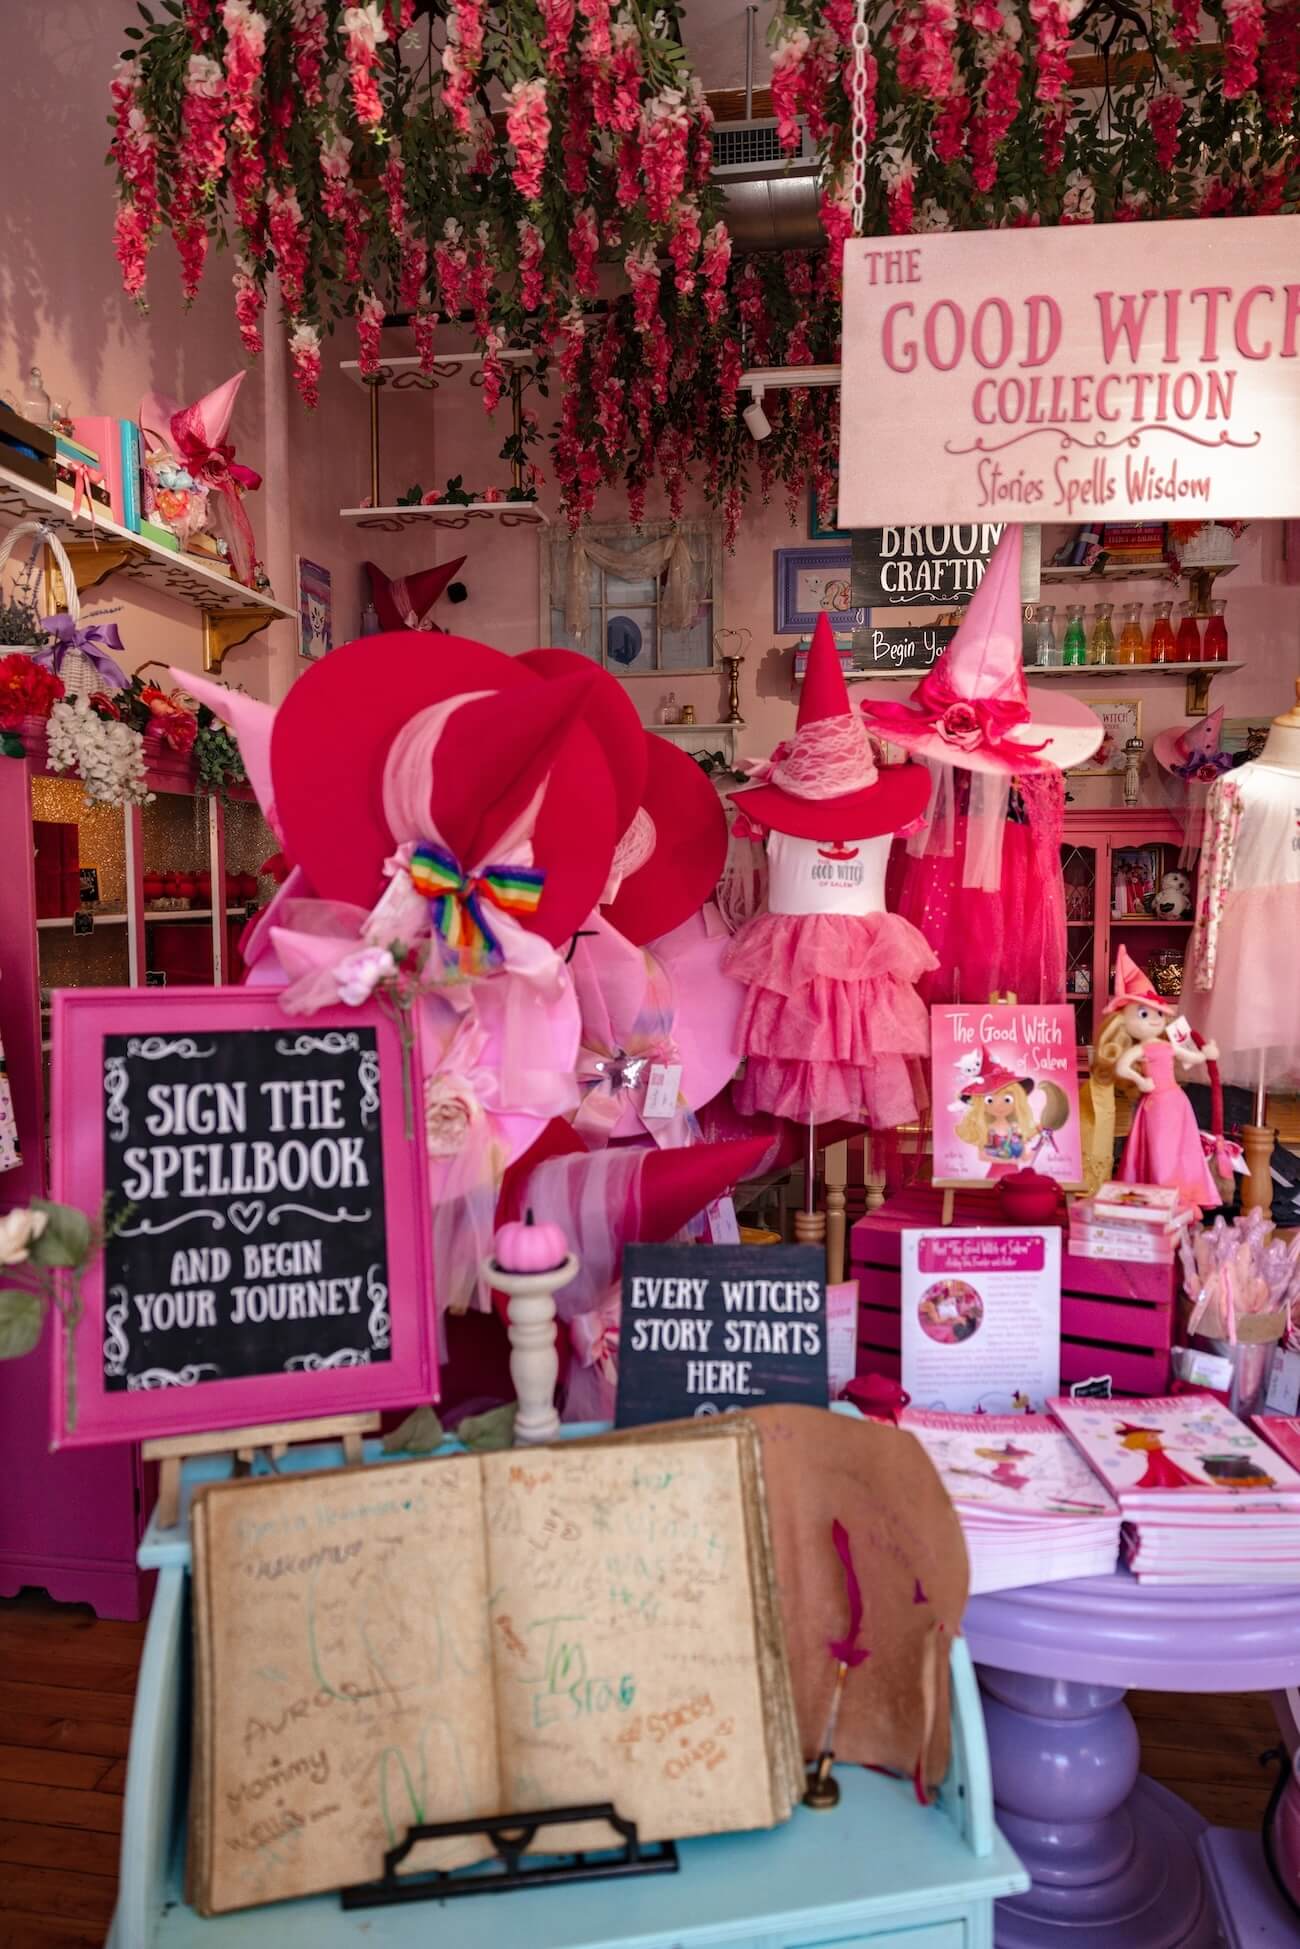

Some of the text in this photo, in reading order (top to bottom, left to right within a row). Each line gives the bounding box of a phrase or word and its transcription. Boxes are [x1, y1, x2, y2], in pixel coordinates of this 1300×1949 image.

[865, 248, 922, 285] THE
[882, 294, 1062, 373] GOOD
[972, 370, 1237, 424] COLLECTION
[977, 454, 1211, 514] Stories Spells Wisdom
[872, 629, 946, 666] Begin Yo
[945, 1012, 1062, 1045] The Good Witch
[1033, 1048, 1068, 1071] Salem
[145, 1079, 345, 1136] SIGN THE
[122, 1137, 369, 1200] SPELLBOOK
[170, 1239, 322, 1286] AND BEGIN
[134, 1277, 363, 1332] YOUR JOURNEY
[631, 1276, 709, 1311] EVERY
[631, 1318, 713, 1352] STORY
[724, 1320, 821, 1355] STARTS
